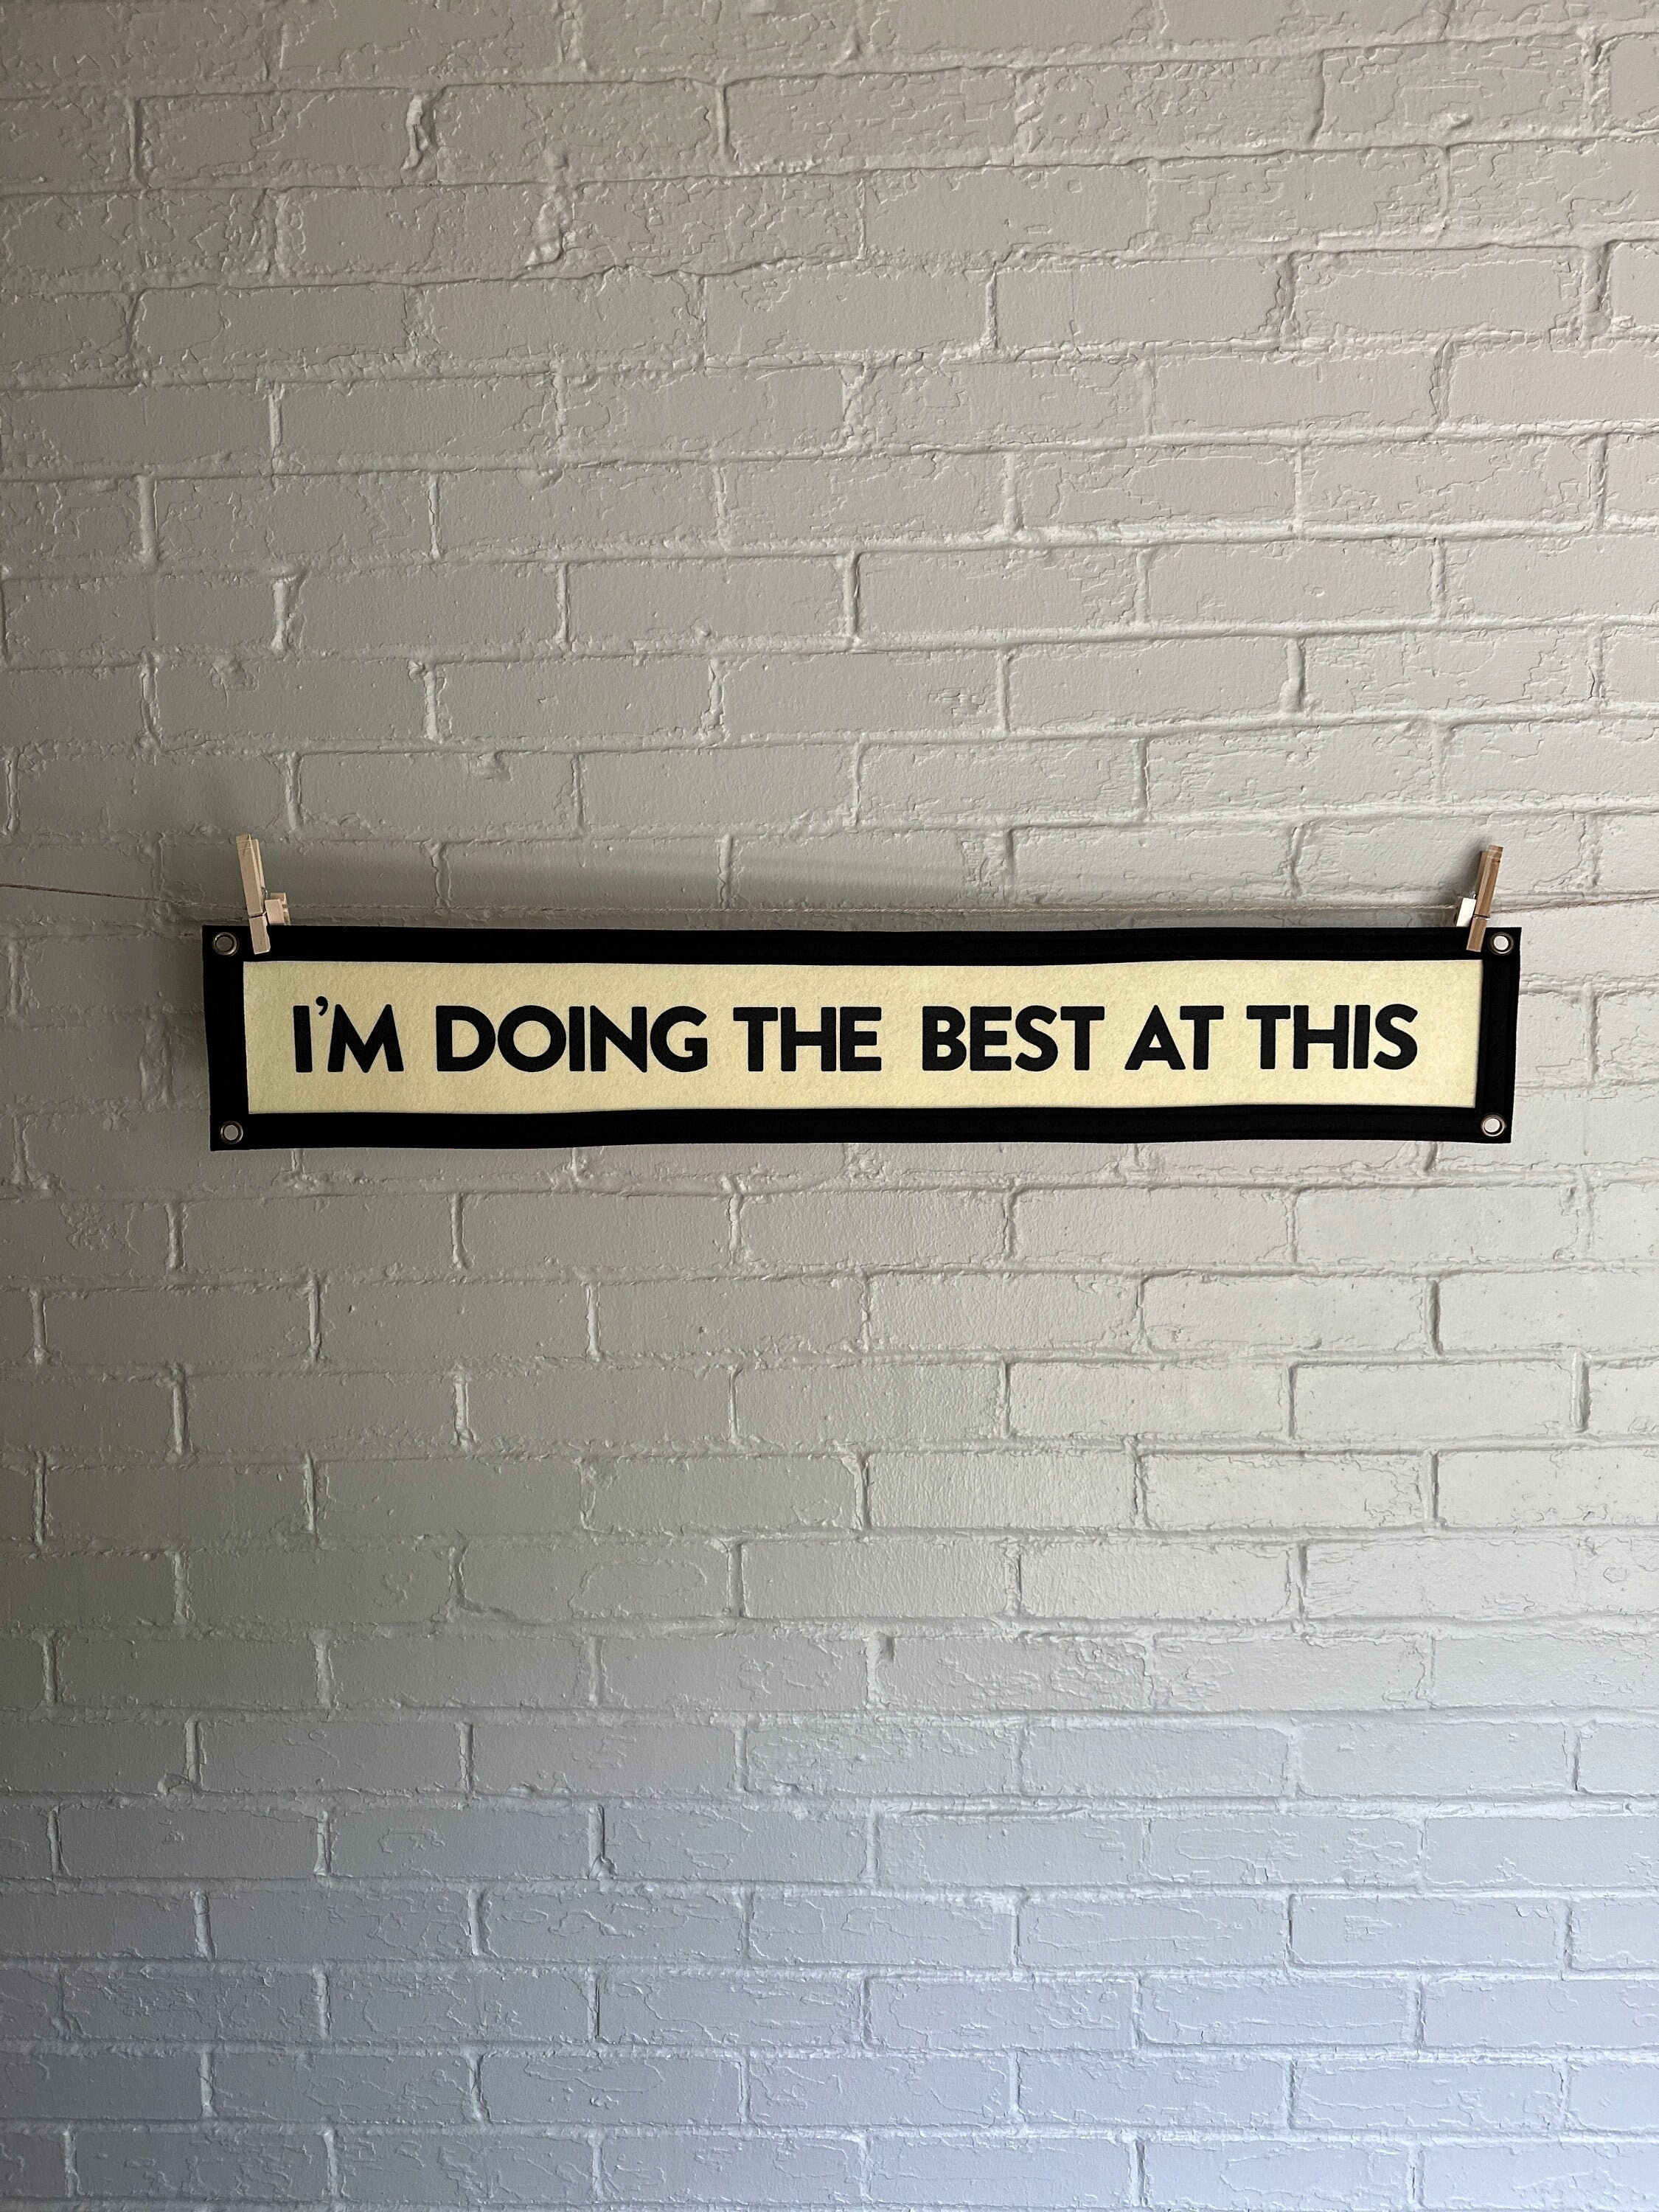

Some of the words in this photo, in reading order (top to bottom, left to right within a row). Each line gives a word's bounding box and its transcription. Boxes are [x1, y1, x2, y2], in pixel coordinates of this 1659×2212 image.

[293, 996, 404, 1073] I’M
[436, 1005, 707, 1073] DOING
[733, 1006, 881, 1071] THE
[922, 1006, 1105, 1071] BEST
[1124, 1005, 1224, 1071] AT
[1247, 1004, 1418, 1070] THIS
